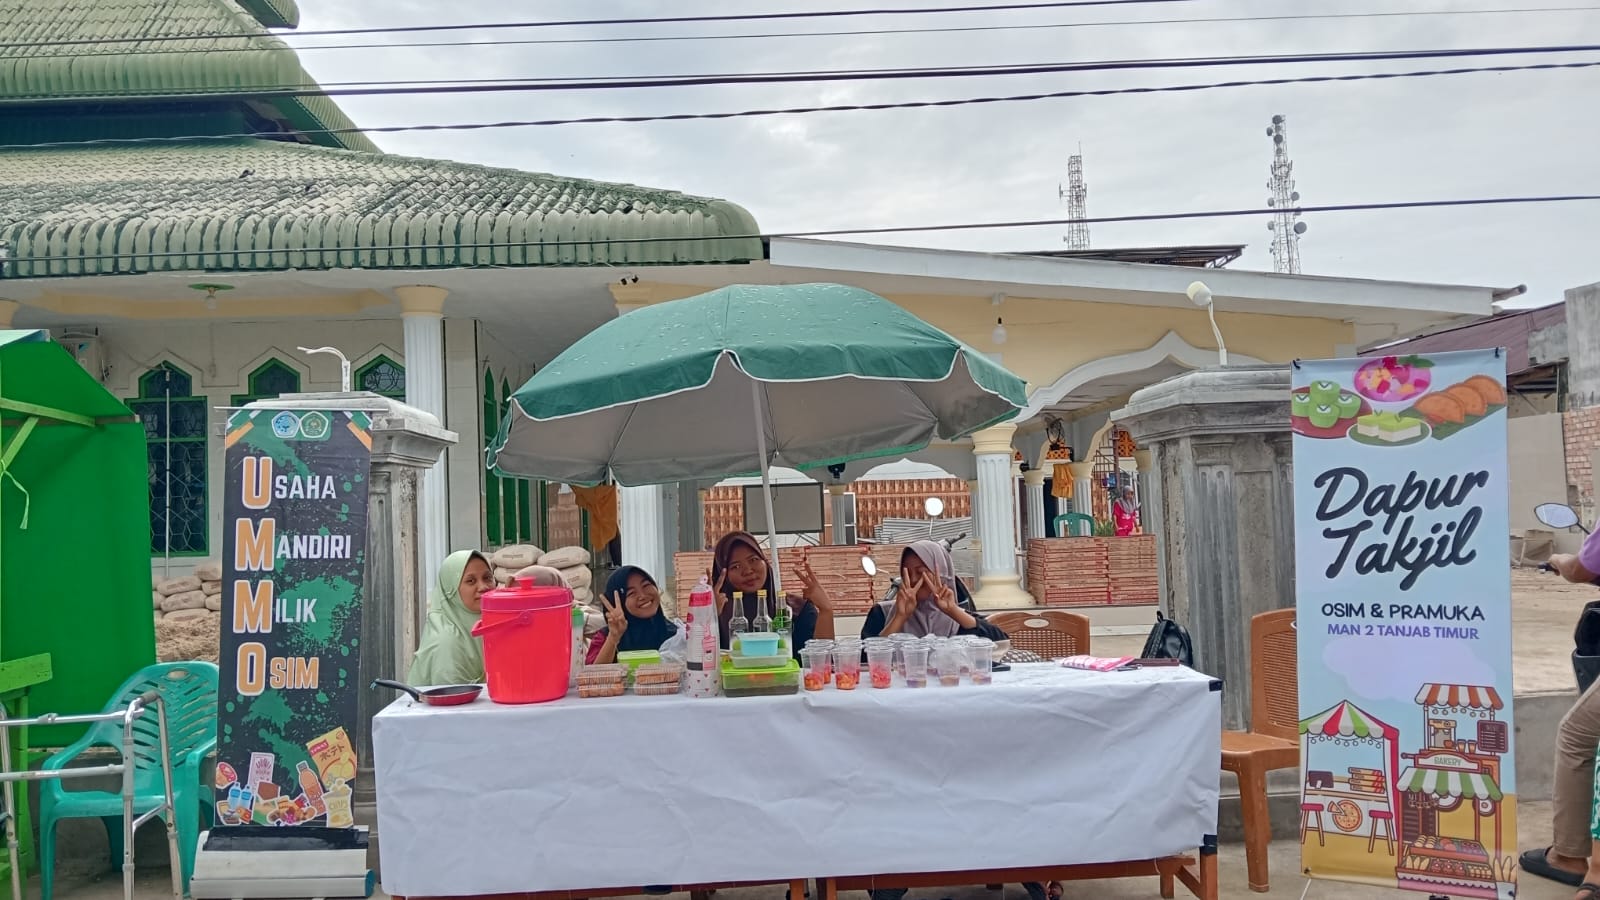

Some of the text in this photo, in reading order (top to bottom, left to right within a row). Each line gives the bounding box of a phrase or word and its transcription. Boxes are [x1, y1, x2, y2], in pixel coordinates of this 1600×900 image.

[242, 456, 337, 510] USAHA
[1314, 467, 1489, 535] Dapur
[234, 518, 351, 571] MANDIRI
[1322, 506, 1483, 591] Takjil
[233, 580, 317, 634] MILIK
[1321, 603, 1485, 621] OSIM & PRAMUKA
[1327, 623, 1480, 640] MAN 2 TANJAB TIMUR
[236, 642, 319, 696] OSIM
[1434, 756, 1461, 766] BAKERY
